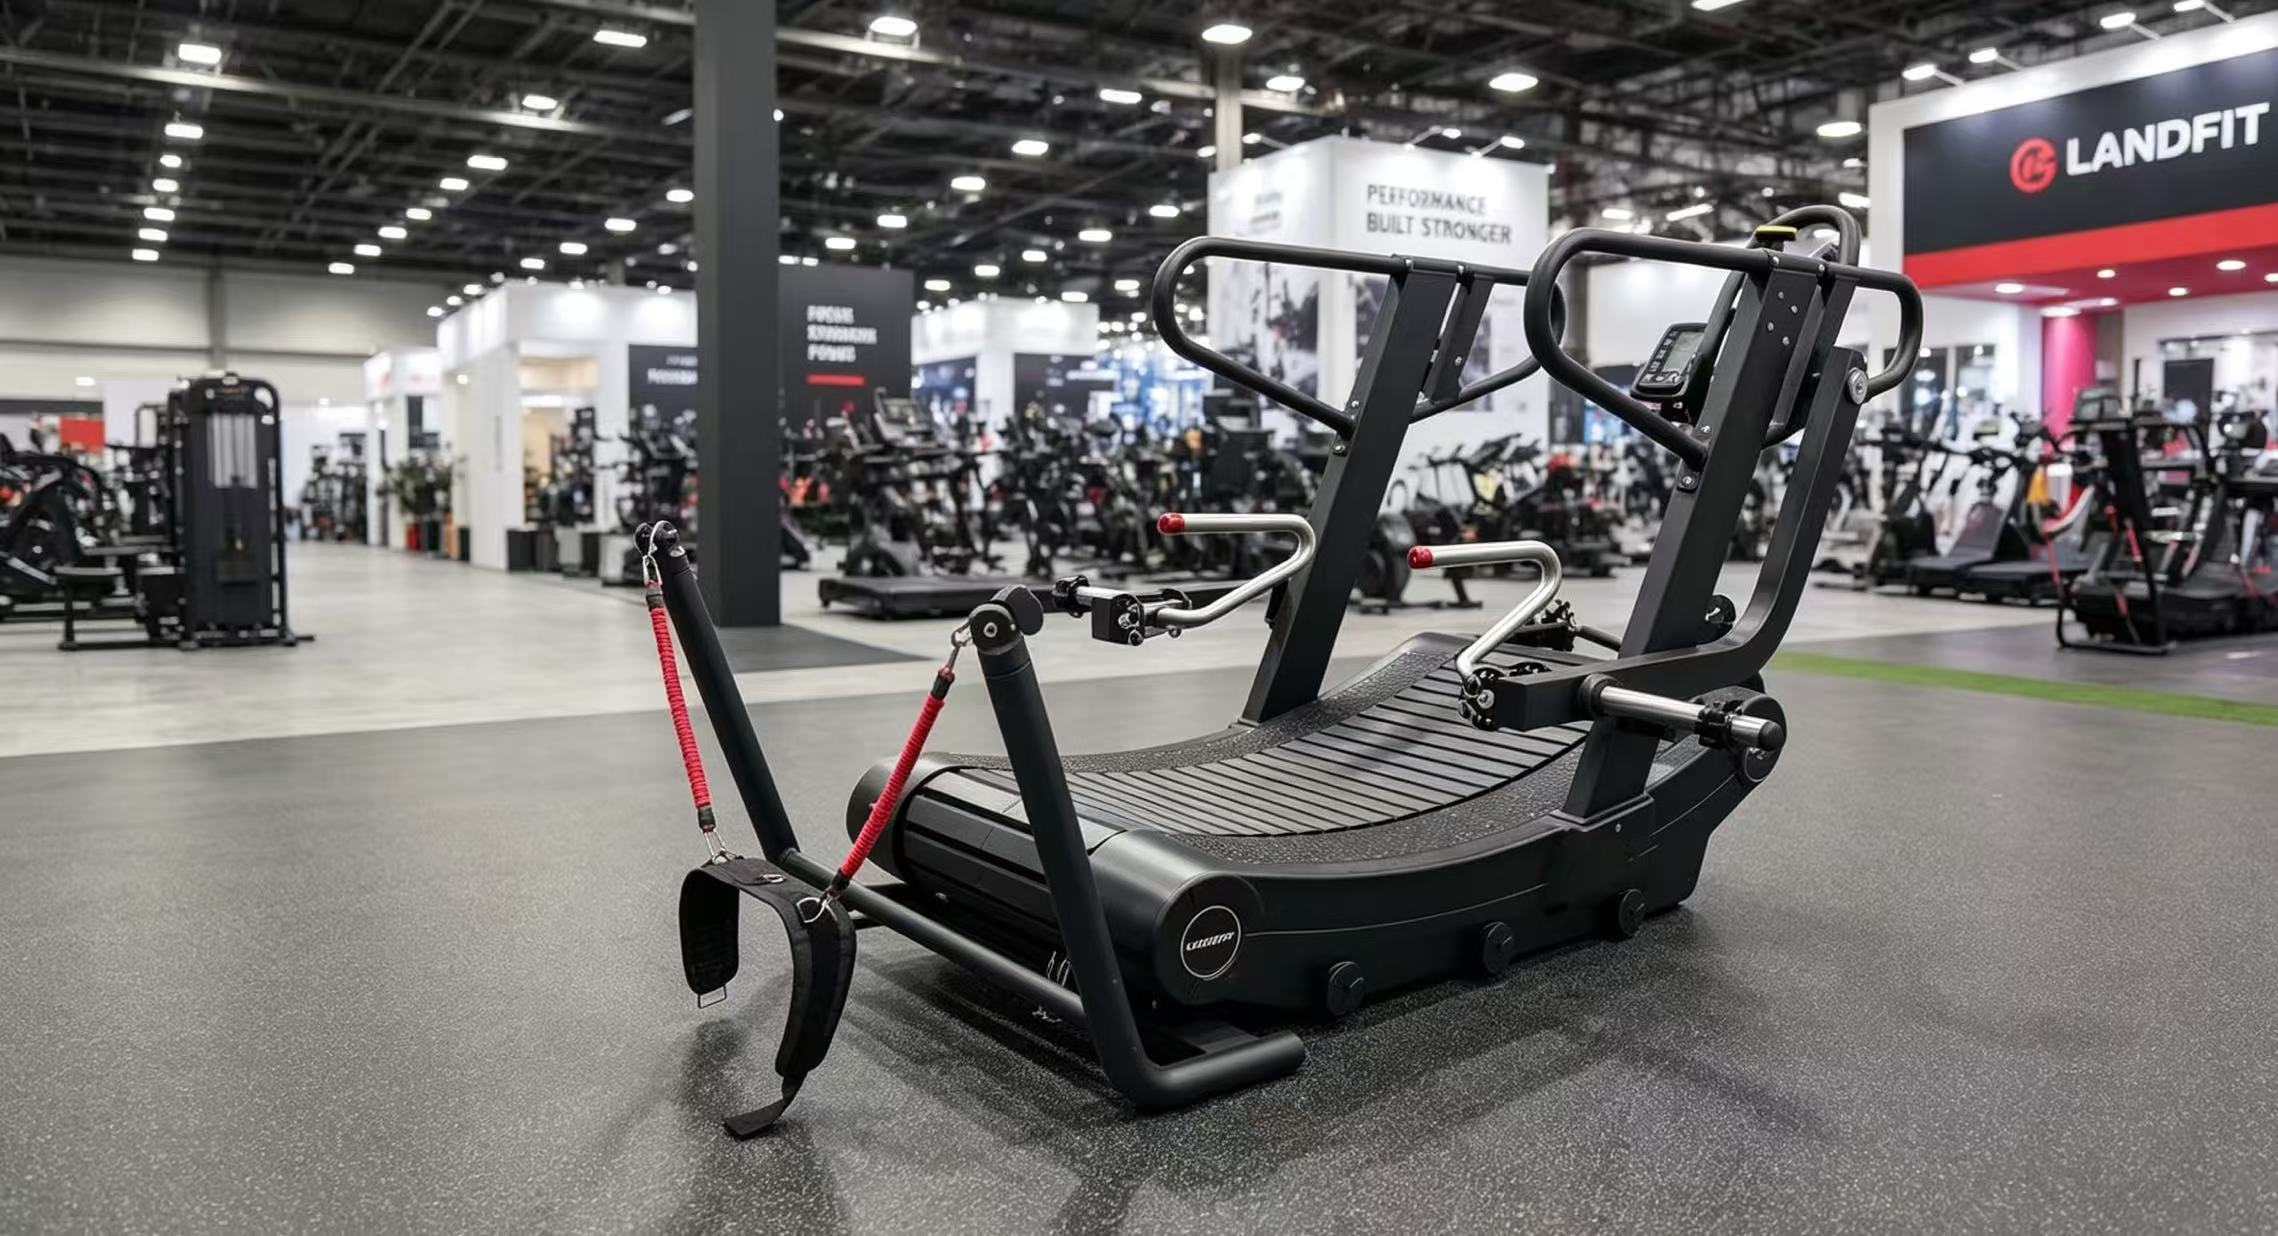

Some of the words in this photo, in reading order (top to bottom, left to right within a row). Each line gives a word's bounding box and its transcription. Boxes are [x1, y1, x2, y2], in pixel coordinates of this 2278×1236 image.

[2065, 102, 2270, 176] LANDFIT
[1366, 212, 1414, 235] BUILT
[1421, 217, 1513, 245] STRONGER
